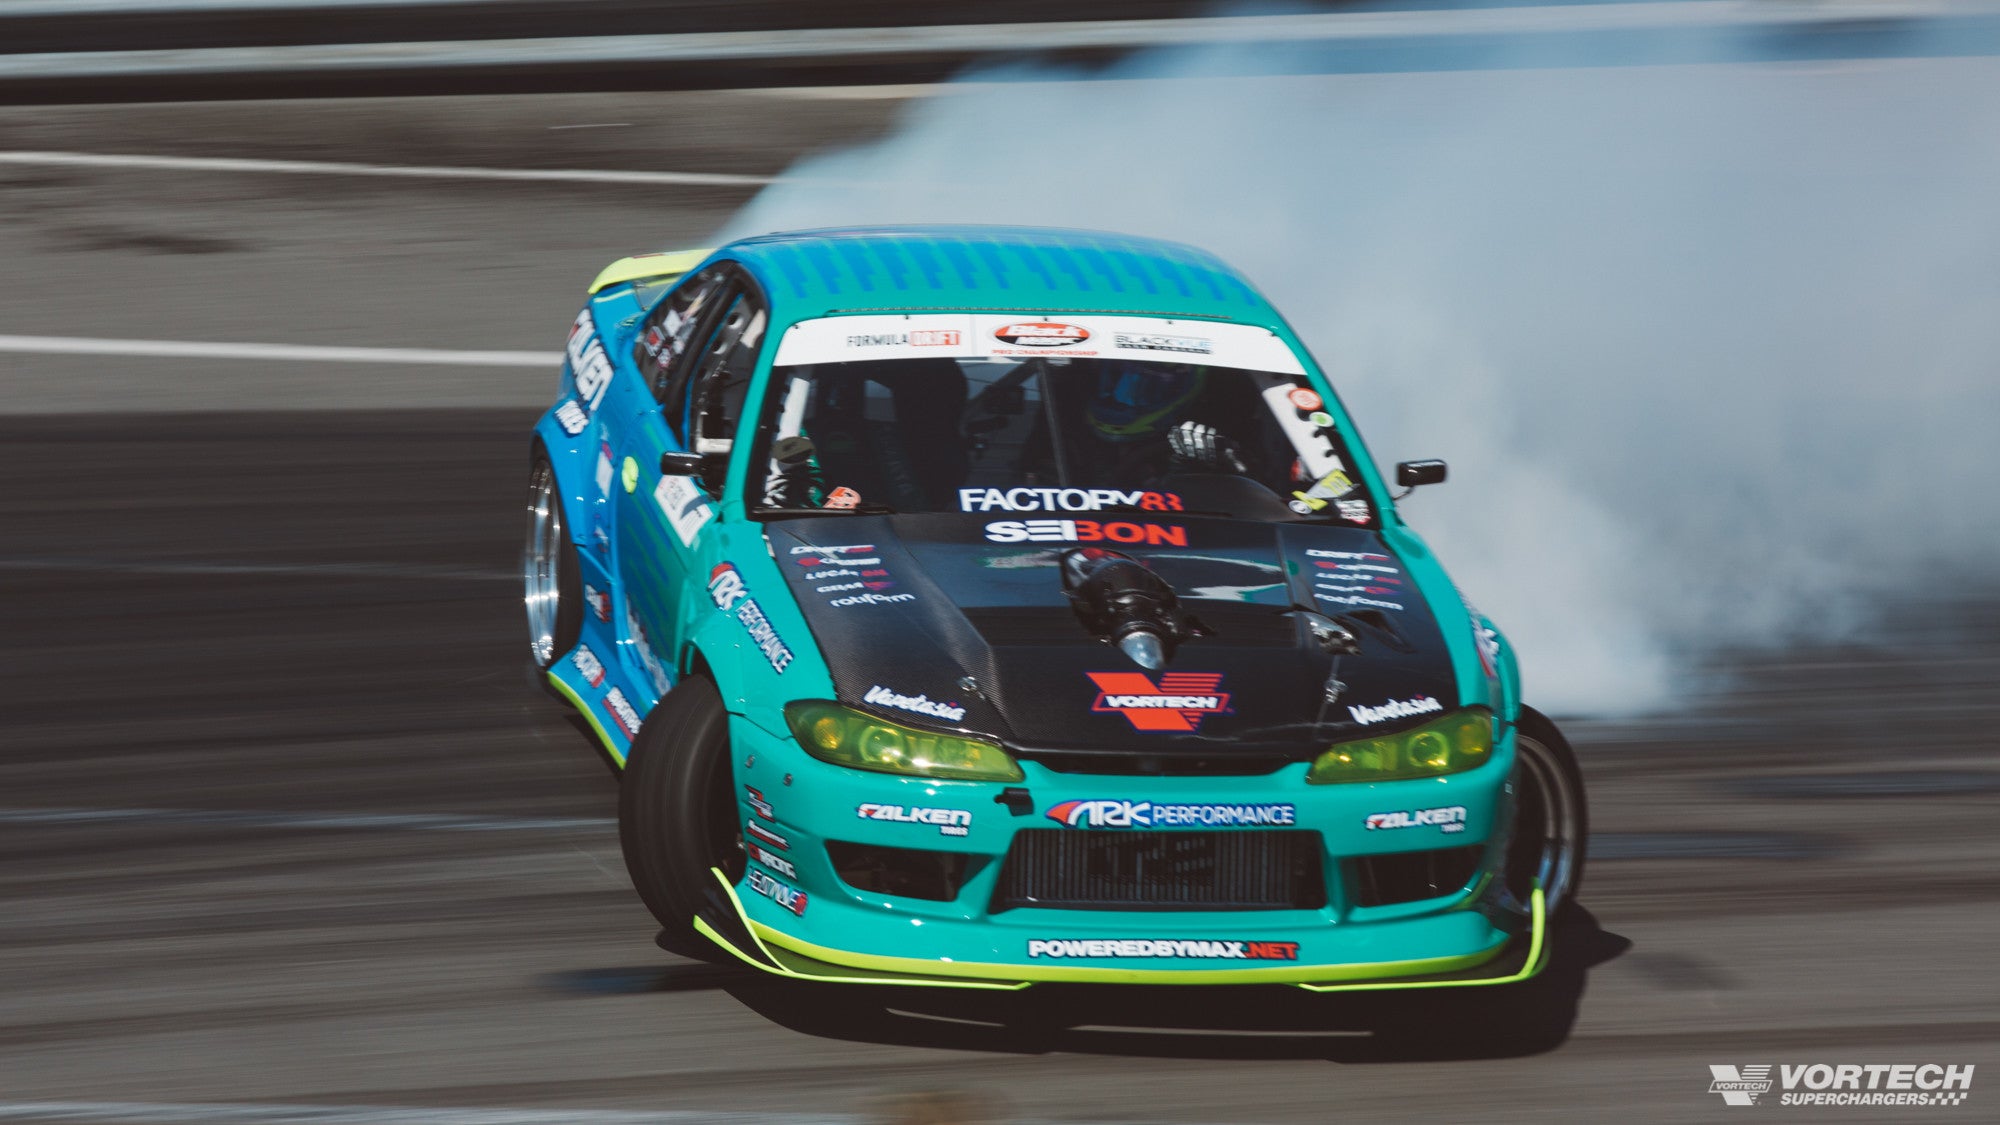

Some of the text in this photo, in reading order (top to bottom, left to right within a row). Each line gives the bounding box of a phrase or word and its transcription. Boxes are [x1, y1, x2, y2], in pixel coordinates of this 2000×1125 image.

[846, 330, 961, 347] FORMULA DRIFT
[984, 519, 1189, 547] SEIBON
[735, 598, 794, 674] PERFORMANCE
[1105, 695, 1218, 709] VORTECH
[857, 803, 972, 827] FALKEN
[1048, 801, 1294, 827] ARK PERFORMANCE
[1365, 806, 1466, 830] FALKEN
[1028, 939, 1299, 960] POWEREDBYMAX.NET
